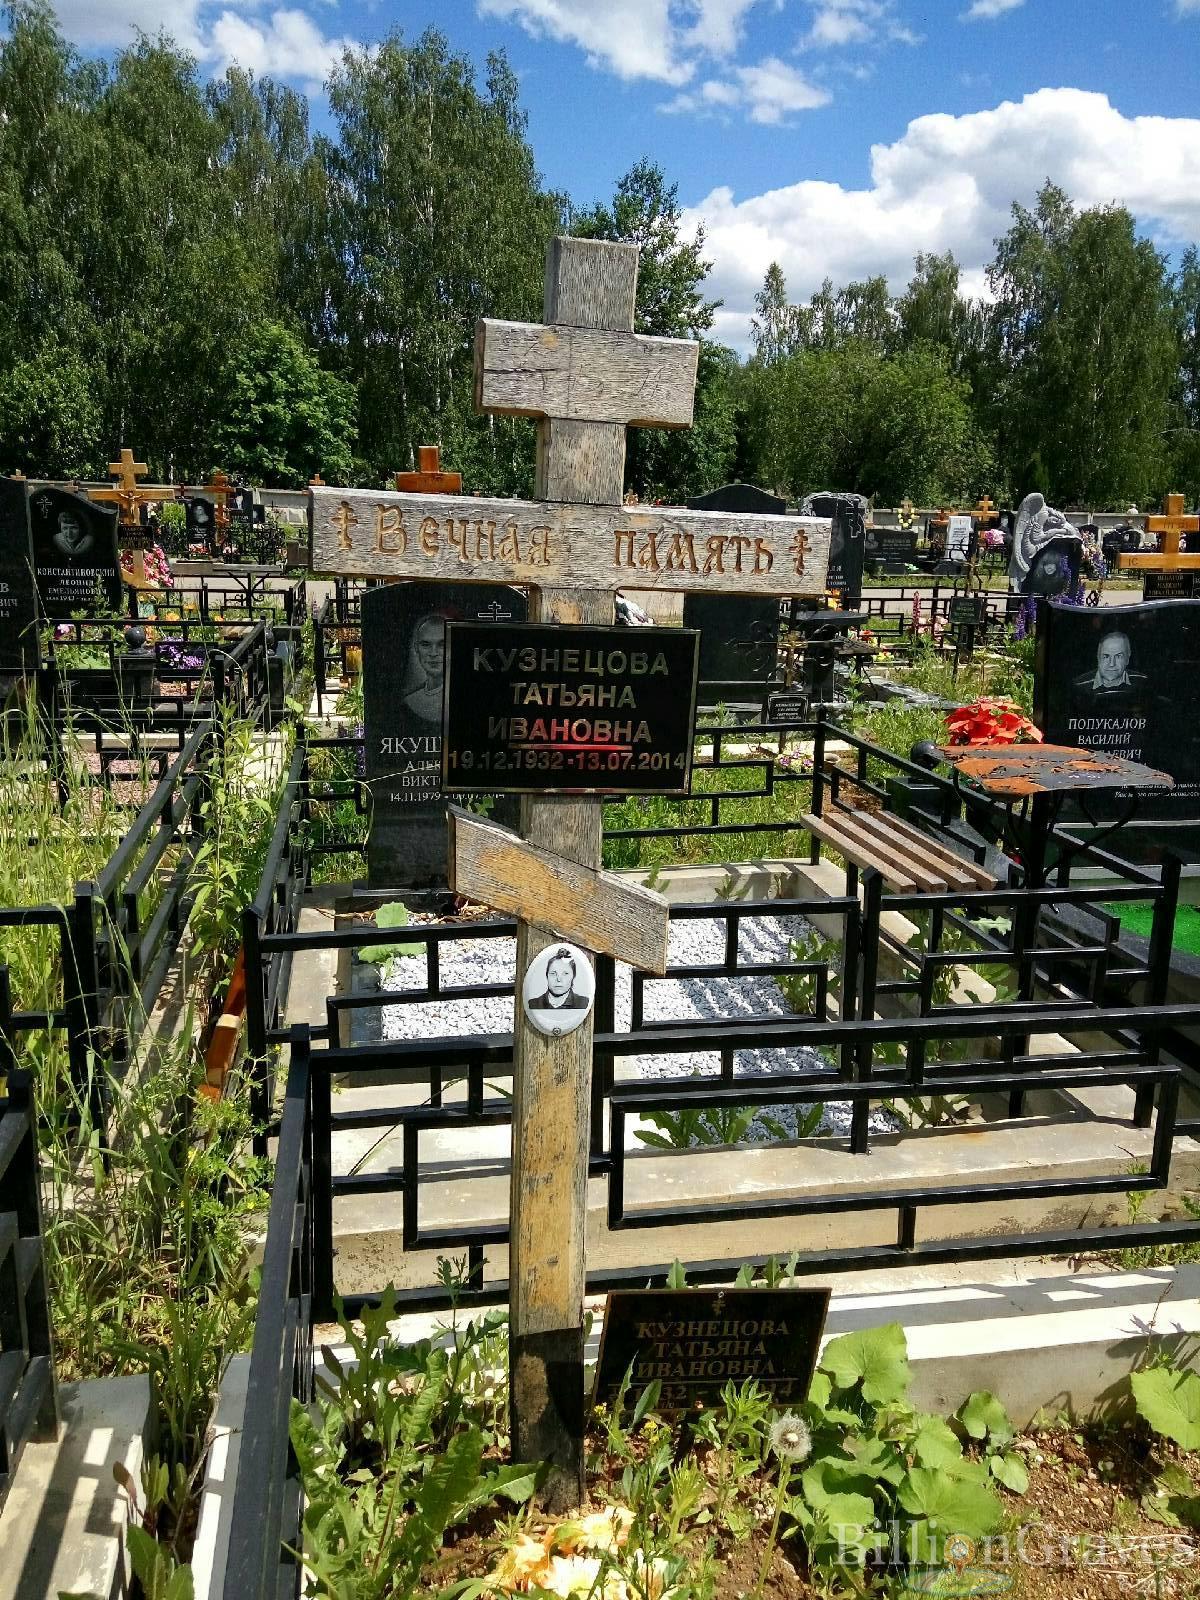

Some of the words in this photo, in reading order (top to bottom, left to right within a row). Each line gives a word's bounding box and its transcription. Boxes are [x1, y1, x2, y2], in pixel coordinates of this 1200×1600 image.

[473, 647, 670, 677] КУЗНЕЦОВА
[511, 682, 637, 709] ТАТЬЯНА
[488, 716, 652, 744] ИВАНОВНА
[1068, 718, 1147, 730] ПОПУКАЛОВ
[379, 736, 442, 754] ЯКУШ
[1077, 732, 1131, 745] ВАСИЛИЙ
[404, 759, 441, 771] АЛЕК
[390, 791, 441, 802] 14.11.1979
[636, 1319, 790, 1338] КУЗНЕЦОВА
[654, 1340, 768, 1358] ТАТЬЯНА
[636, 1359, 775, 1378] ИВАНОВНА
